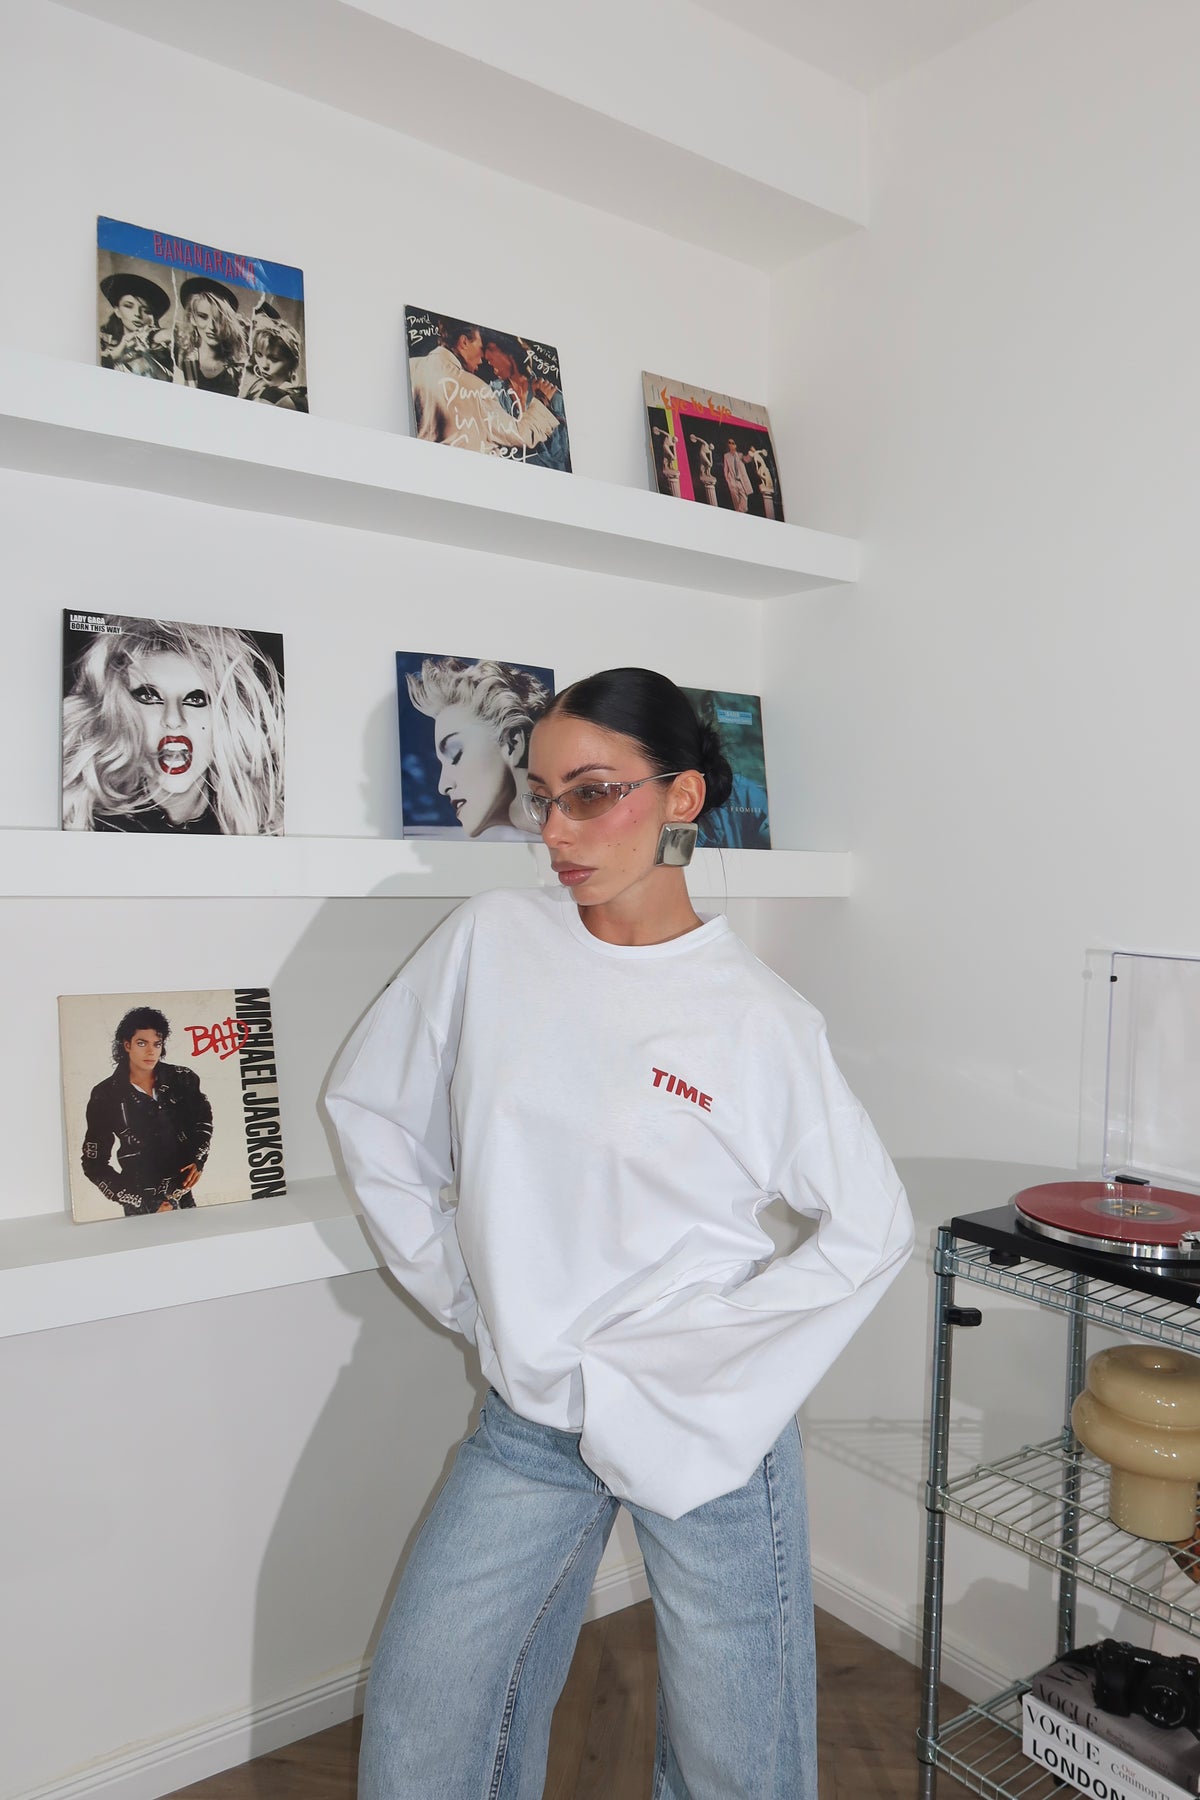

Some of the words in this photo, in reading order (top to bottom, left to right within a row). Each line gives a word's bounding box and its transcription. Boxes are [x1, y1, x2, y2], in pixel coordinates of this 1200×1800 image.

[153, 234, 256, 284] BANANARAMA
[407, 313, 431, 327] David
[408, 324, 441, 346] Bowie
[438, 376, 523, 423] Dancing
[454, 406, 480, 437] in
[70, 614, 87, 623] LADY
[88, 616, 106, 625] GAGA
[71, 623, 89, 631] BORN
[90, 624, 106, 633] THIS
[107, 626, 121, 634] WAY
[184, 1017, 249, 1060] BAD
[235, 988, 278, 1091] MICHAEL
[652, 1067, 713, 1113] TIME
[242, 1091, 287, 1200] JACKSON
[1040, 1683, 1099, 1735] VOGUE
[1027, 1704, 1100, 1766] VOGUE
[1032, 1739, 1126, 1800] LONDON
[1111, 1763, 1157, 1799] Common
